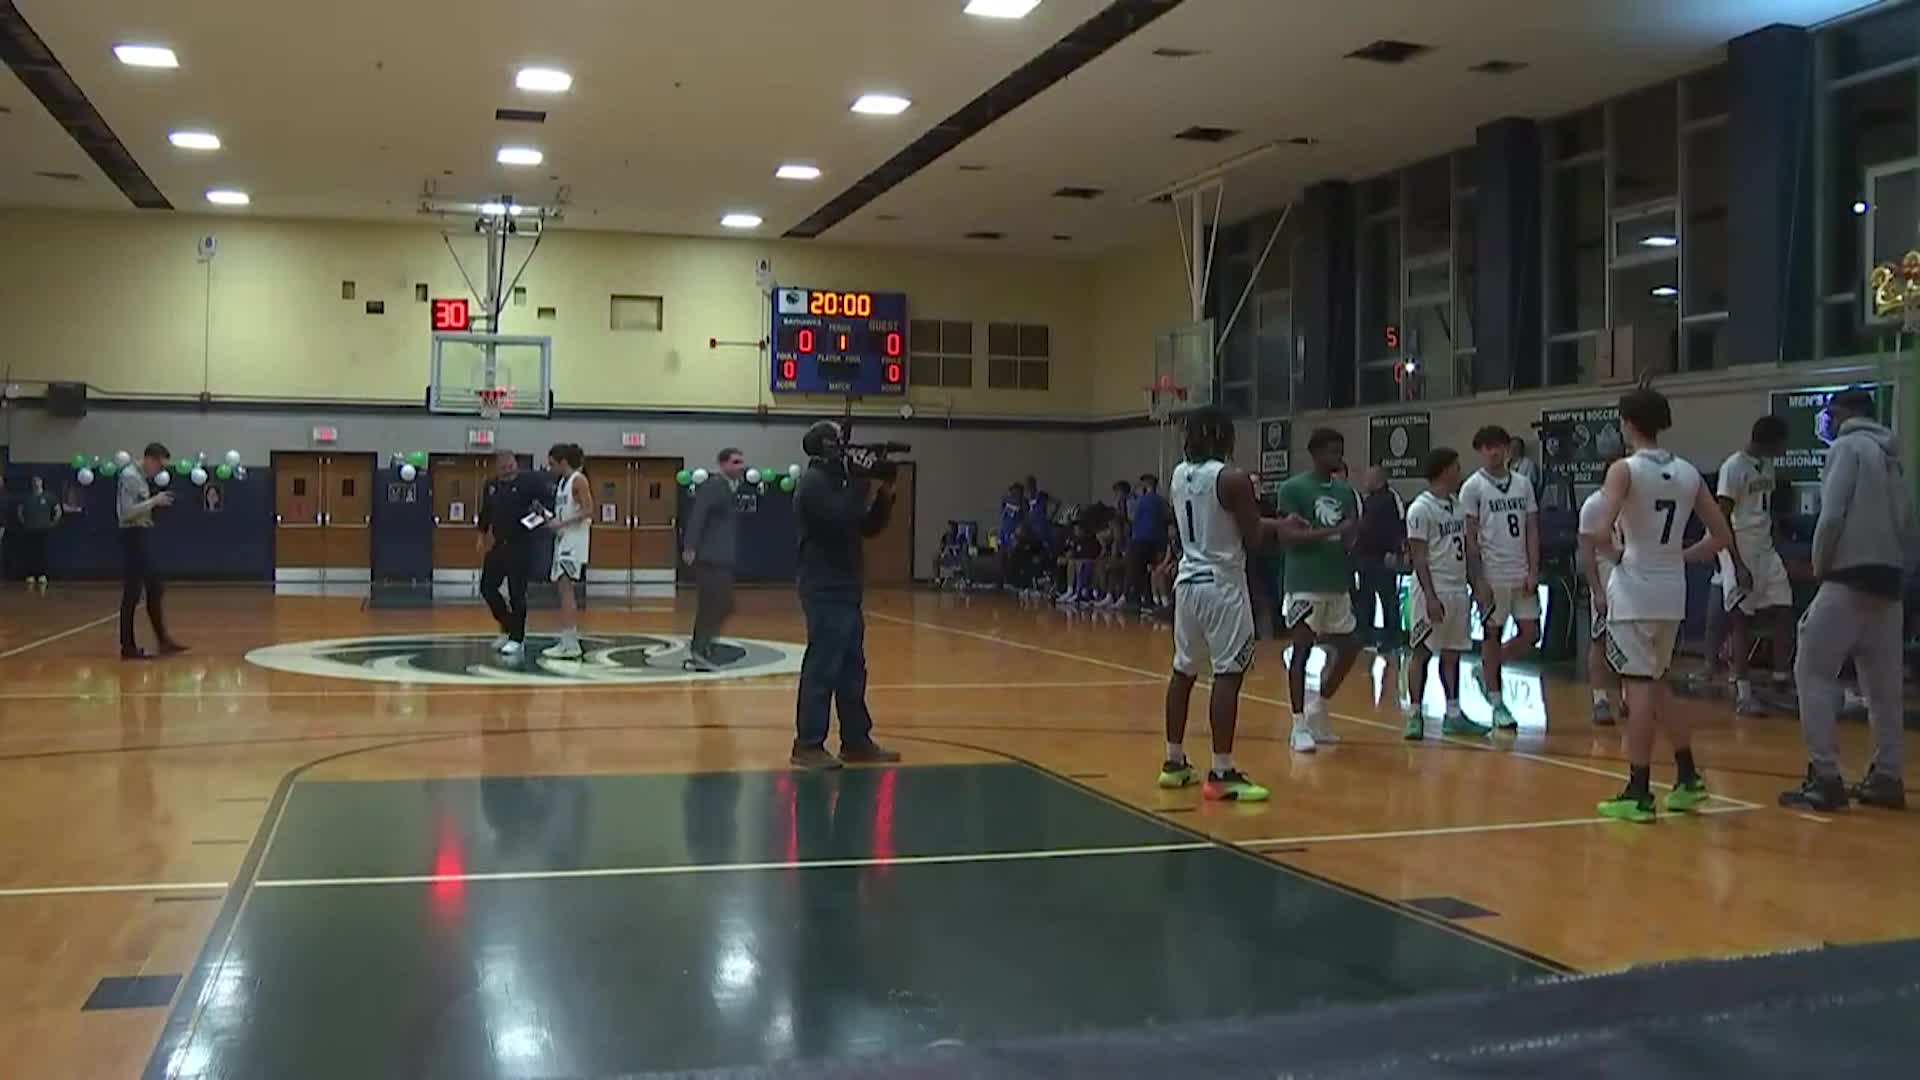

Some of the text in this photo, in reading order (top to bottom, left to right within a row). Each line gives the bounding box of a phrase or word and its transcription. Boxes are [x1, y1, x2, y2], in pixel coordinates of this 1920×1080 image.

[436, 302, 465, 328] 30
[810, 292, 871, 316] 20:00
[799, 329, 813, 352] 0
[839, 334, 846, 350] 1
[887, 333, 900, 356] 0
[783, 360, 795, 379] 0
[888, 364, 900, 383] 0
[1789, 394, 1824, 408] MEN'S
[1774, 456, 1824, 467] REGIONAL
[1185, 499, 1195, 543] 1
[1507, 513, 1520, 538] 8
[1654, 500, 1677, 544] 7
[1453, 536, 1465, 561] 3
